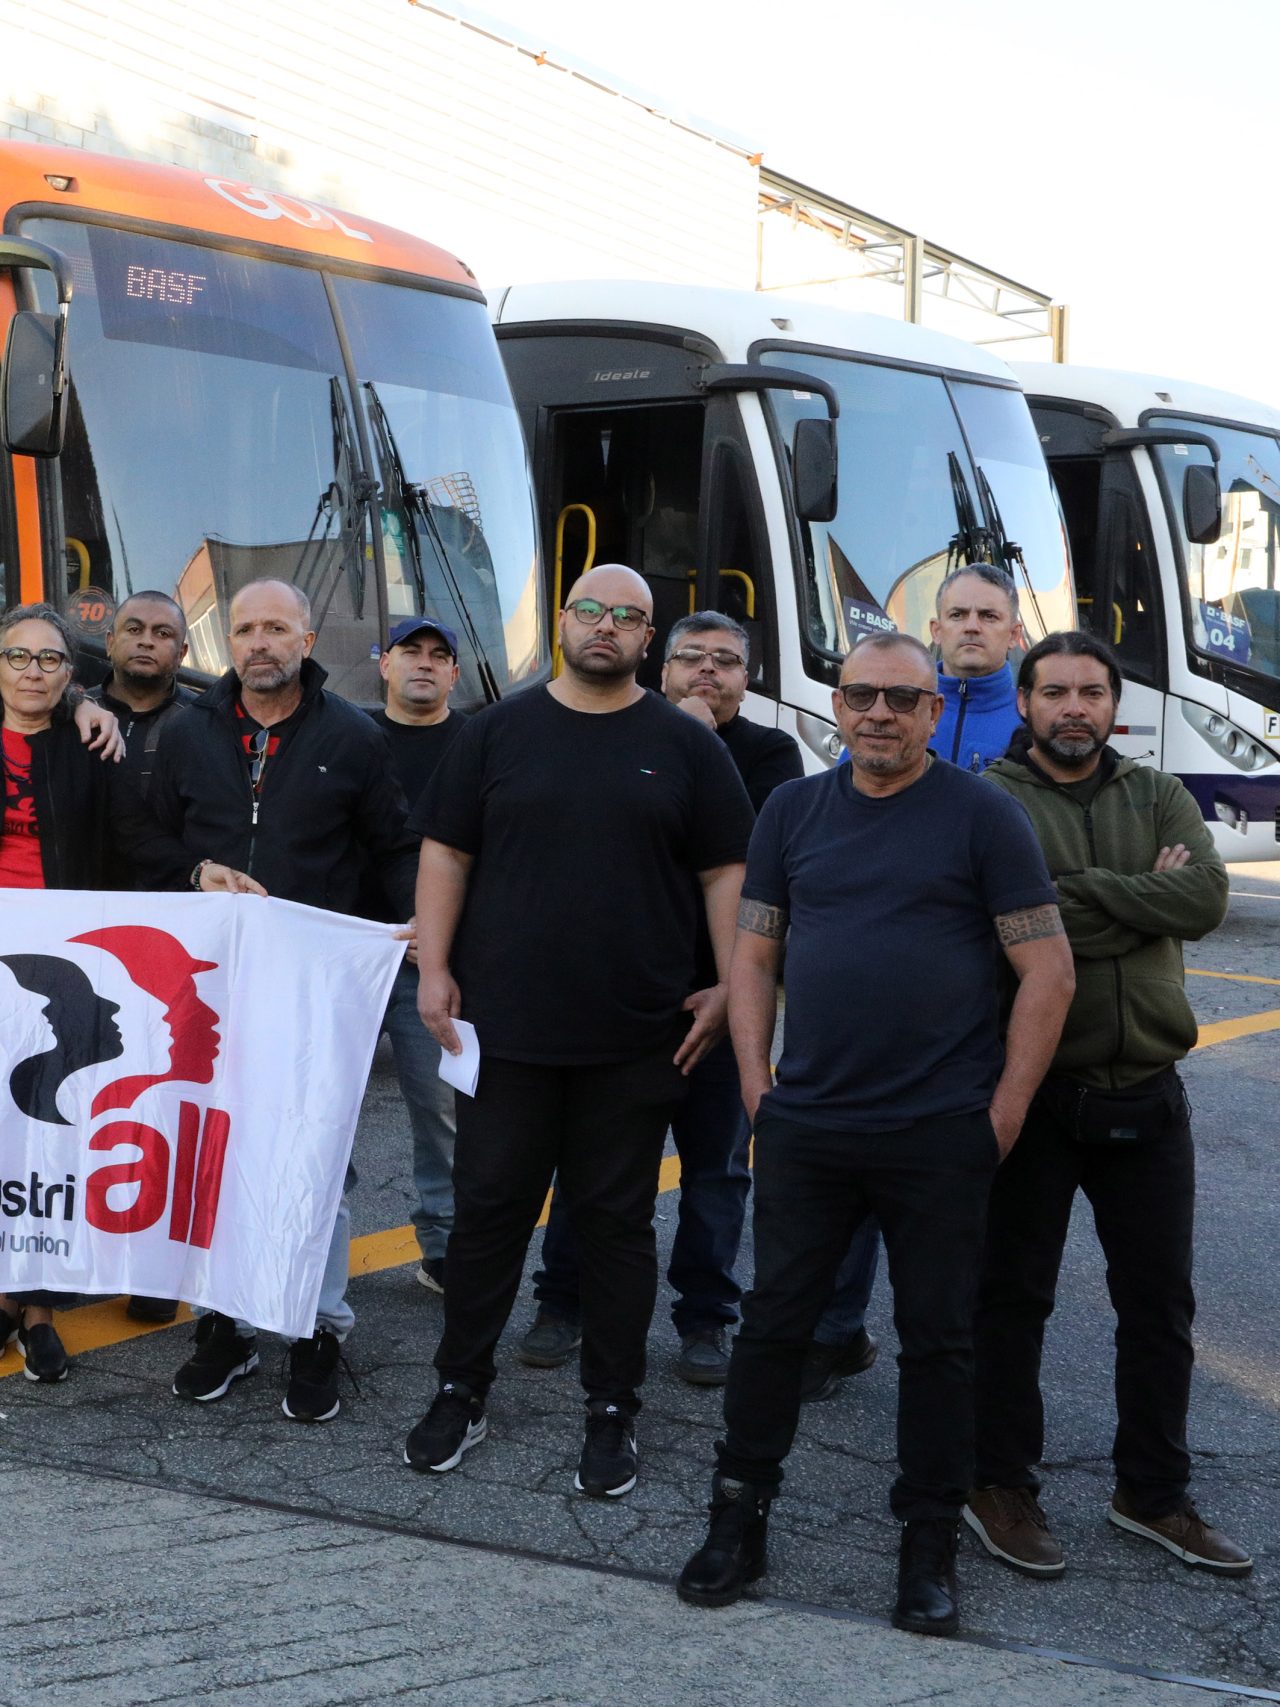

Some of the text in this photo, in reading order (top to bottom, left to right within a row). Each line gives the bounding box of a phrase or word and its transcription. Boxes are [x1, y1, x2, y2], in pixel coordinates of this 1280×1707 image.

[126, 265, 207, 305] BASF
[594, 368, 651, 381] Ideale
[866, 611, 895, 632] BASF
[1210, 628, 1235, 651] 04
[10, 1231, 70, 1257] union
